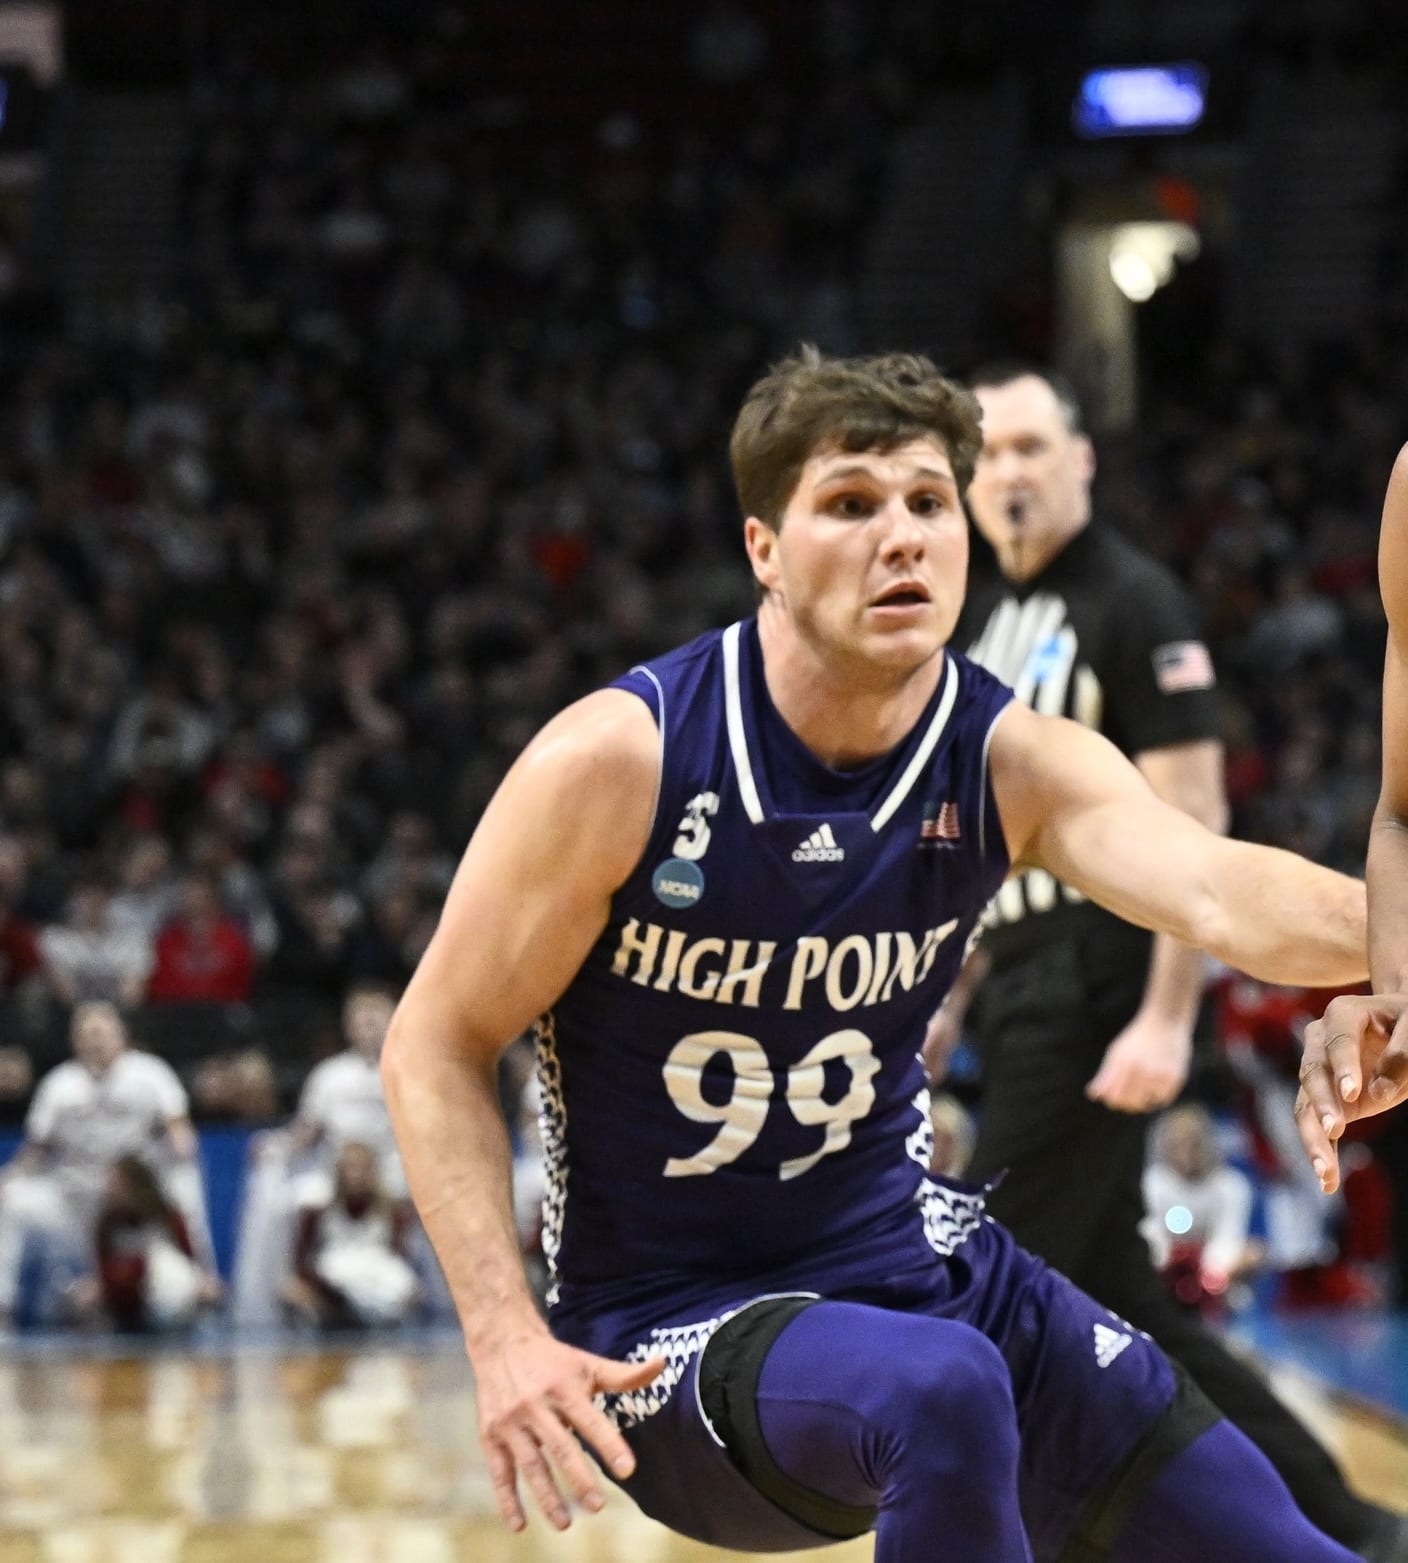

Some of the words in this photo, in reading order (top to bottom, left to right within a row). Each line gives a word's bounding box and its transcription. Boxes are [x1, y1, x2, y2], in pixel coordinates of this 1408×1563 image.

[792, 848, 845, 862] adidas
[659, 879, 700, 900] NCAA
[610, 917, 778, 1008] HIGH
[782, 918, 960, 1012] POINT
[662, 1028, 882, 1182] 99
